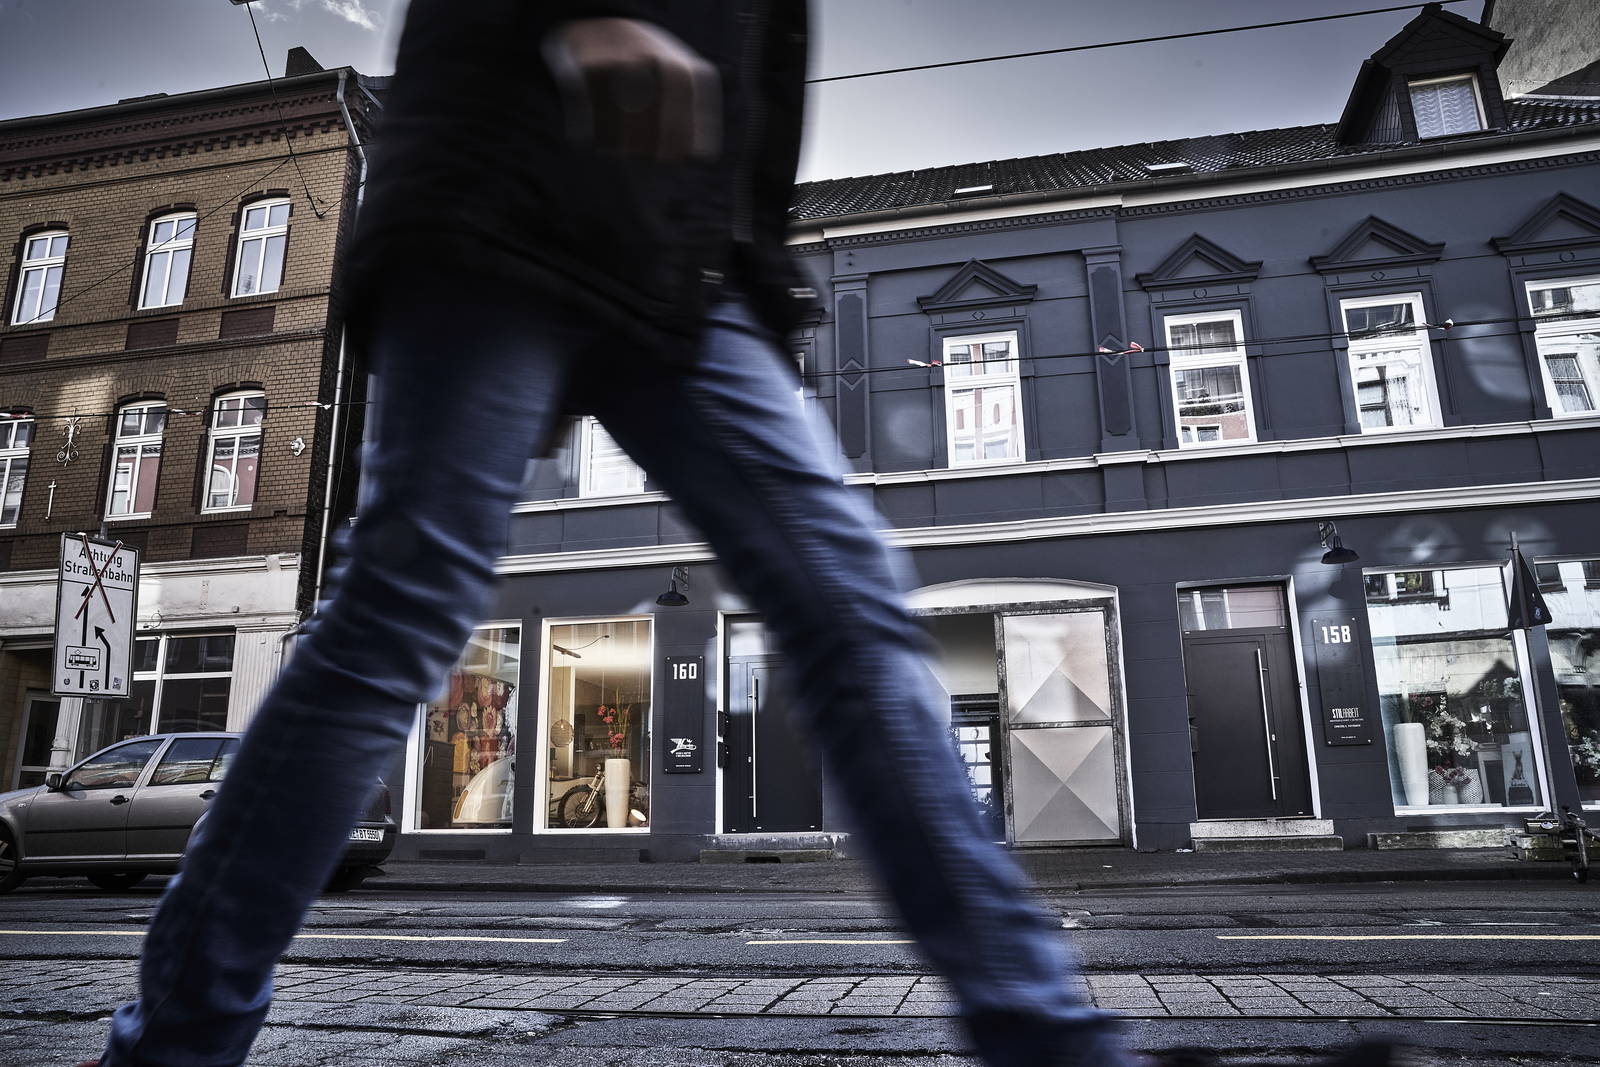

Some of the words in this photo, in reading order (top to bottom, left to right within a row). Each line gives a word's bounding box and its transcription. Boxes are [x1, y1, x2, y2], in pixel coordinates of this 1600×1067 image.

[79, 546, 123, 568] Ahtung
[1321, 625, 1352, 644] 158
[672, 663, 698, 680] 160
